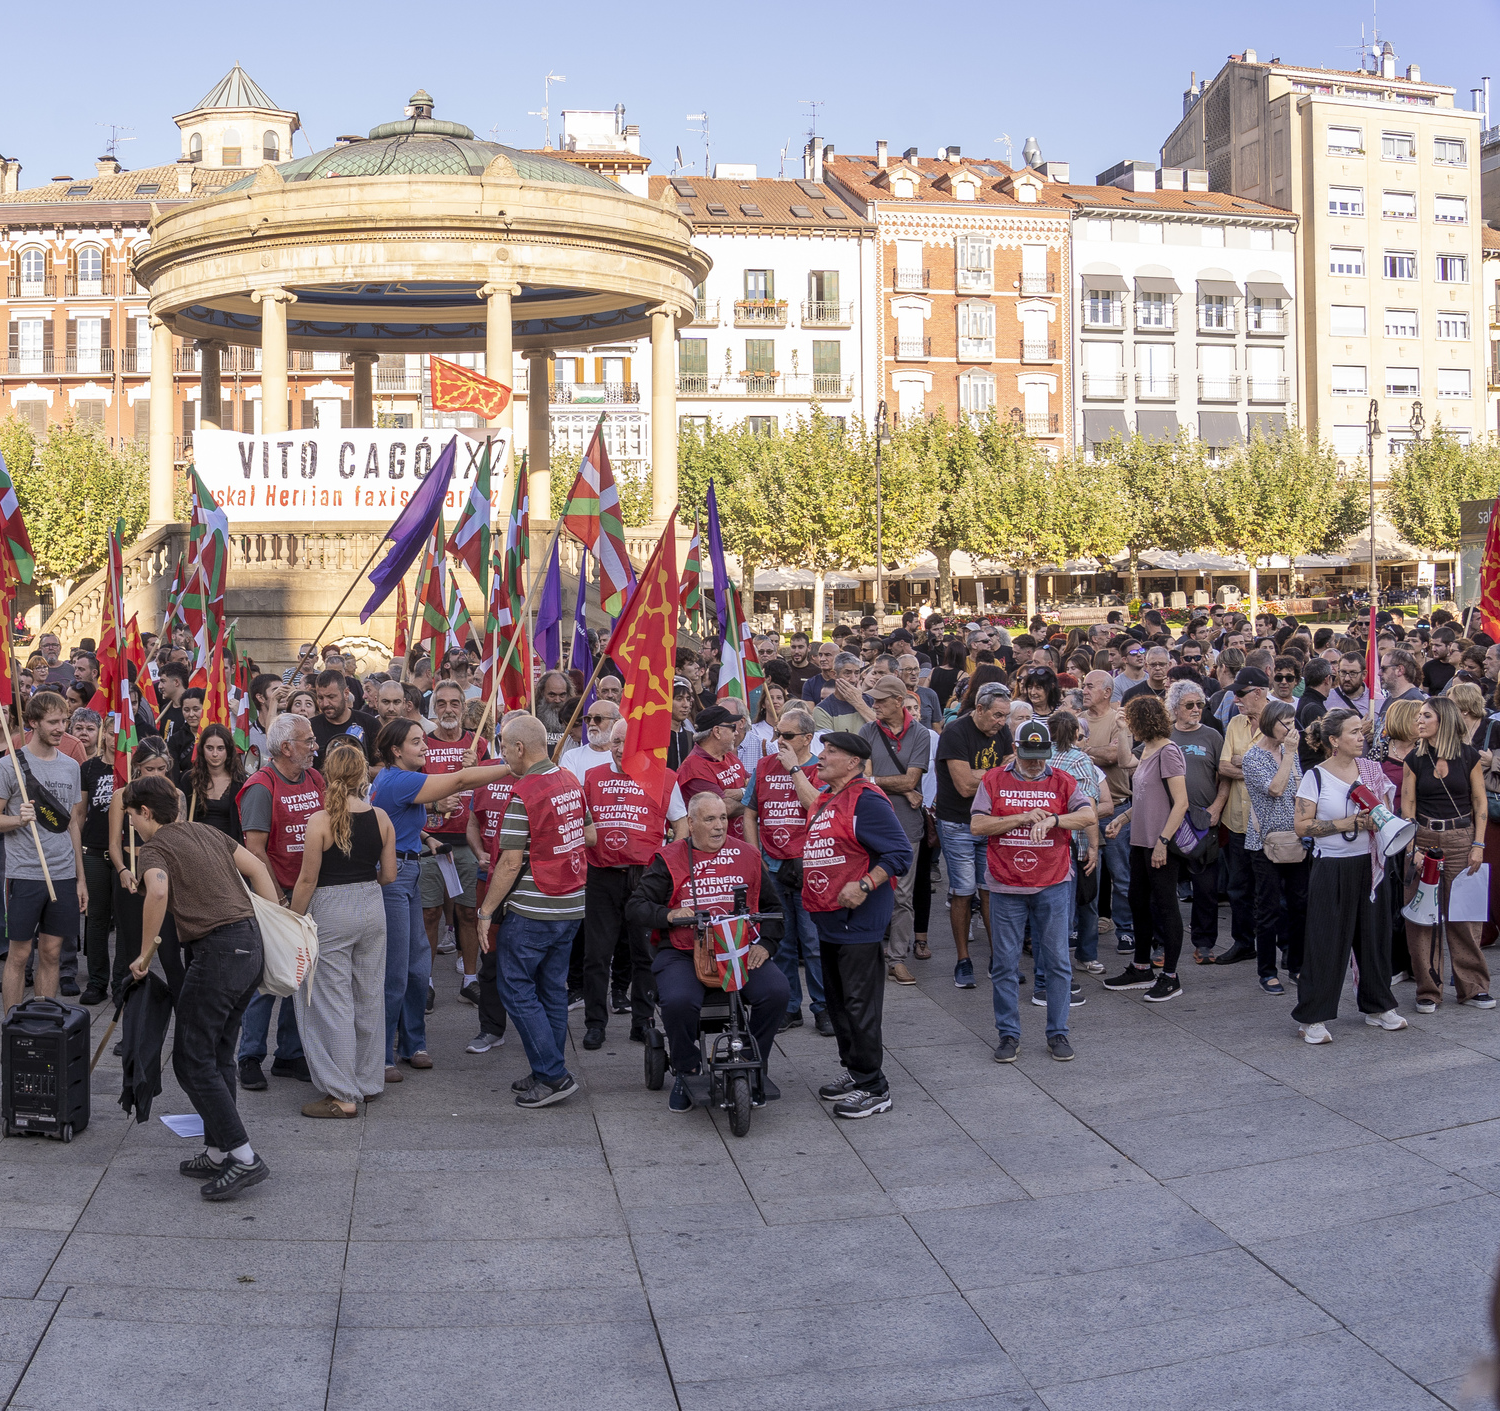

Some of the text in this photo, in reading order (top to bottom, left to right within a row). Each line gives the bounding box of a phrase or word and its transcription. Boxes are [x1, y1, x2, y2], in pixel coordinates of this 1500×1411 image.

[238, 440, 317, 479] VITO
[602, 786, 645, 796] PENTSIOA
[1000, 790, 1056, 799] GUTXIENEKO
[1005, 799, 1050, 807] PENTSIOA
[593, 804, 649, 814] GUTXIENEKO
[599, 812, 639, 821] SOLDATA
[682, 876, 744, 888] TXIENEKO
